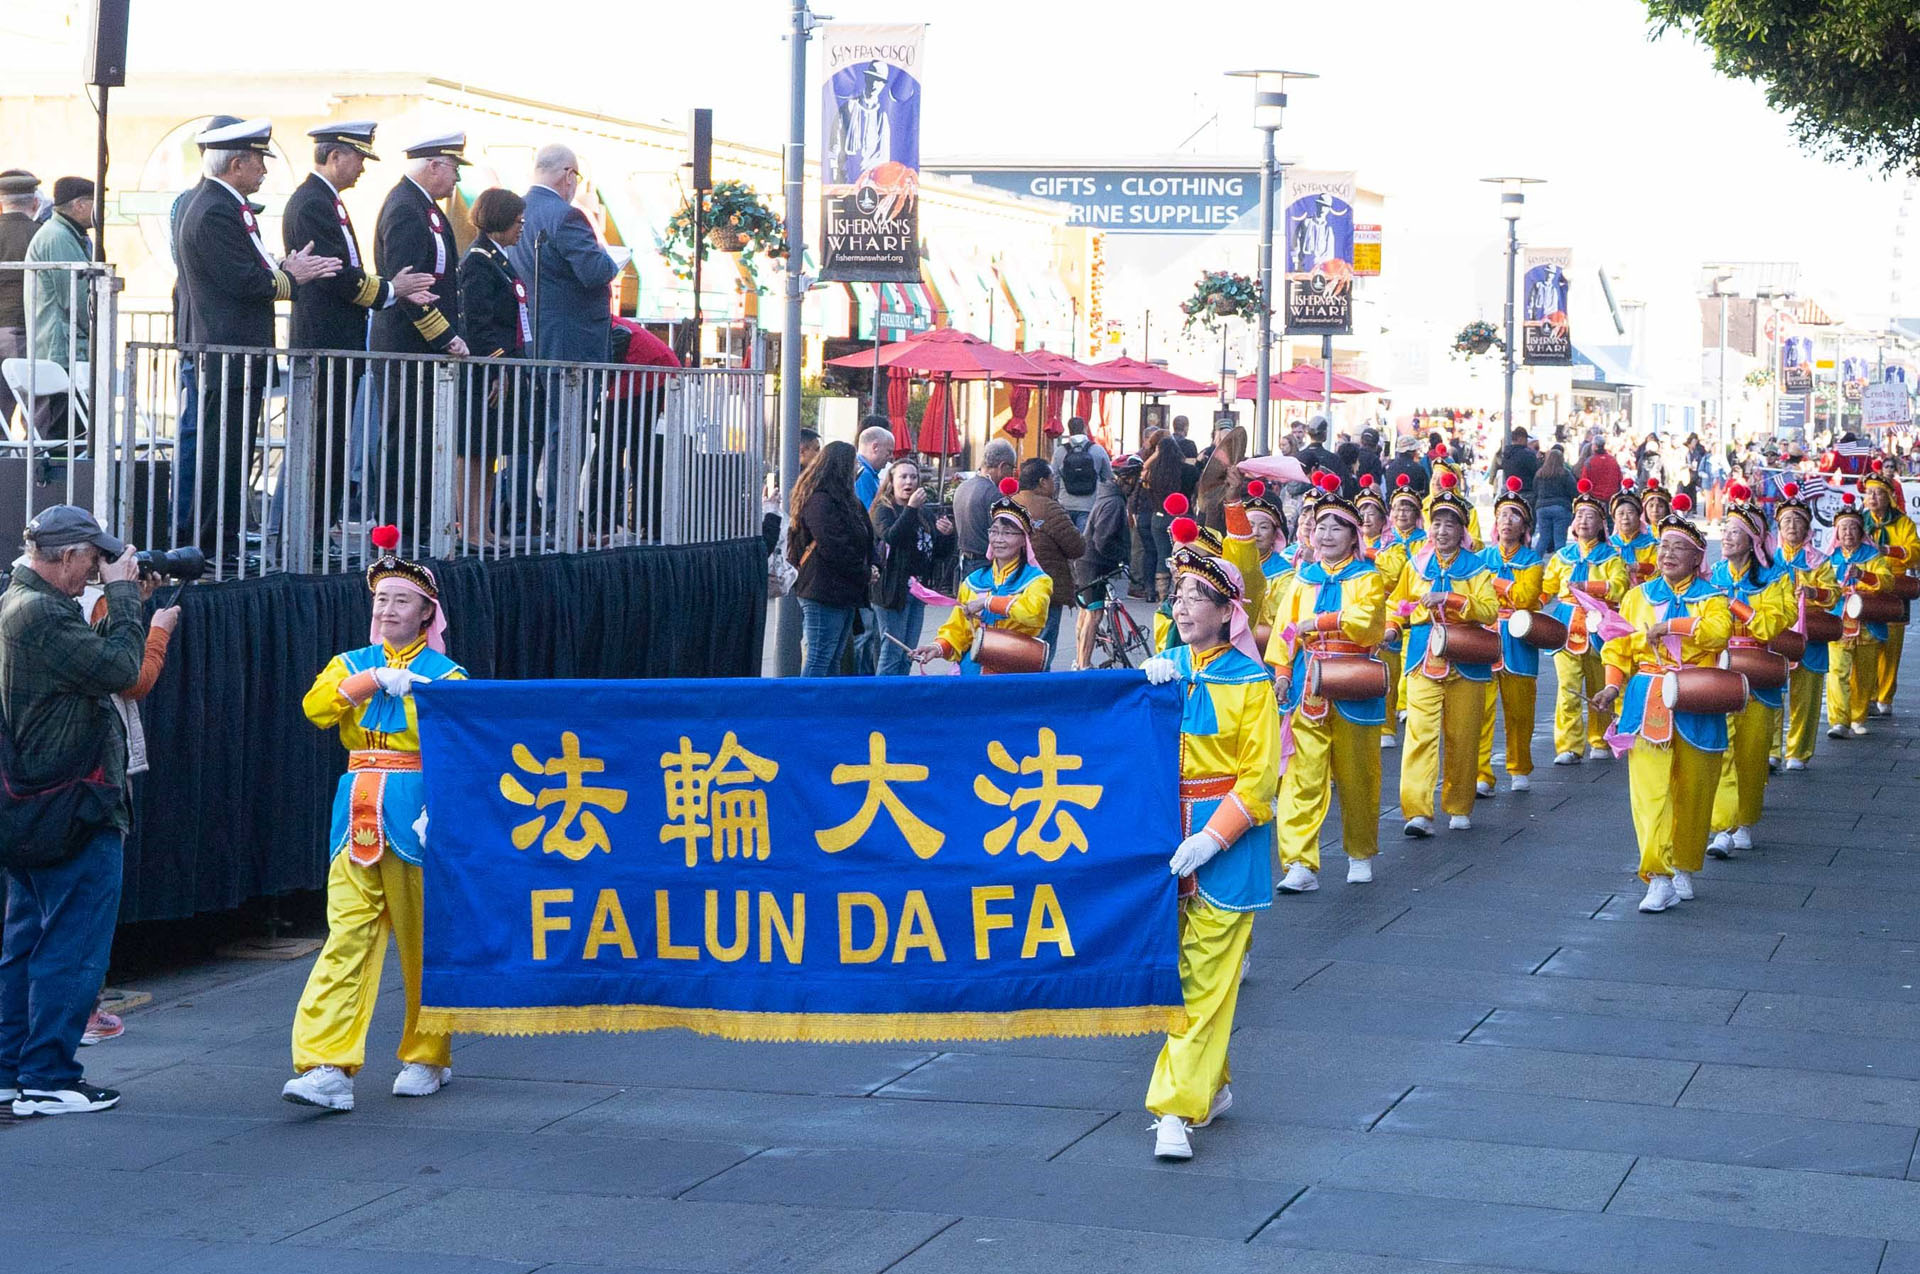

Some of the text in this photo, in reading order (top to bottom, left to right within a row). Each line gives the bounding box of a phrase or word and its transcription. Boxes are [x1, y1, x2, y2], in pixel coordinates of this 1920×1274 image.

[831, 45, 915, 67] SAN FRANCISCO
[1031, 178, 1243, 196] GIFTS CLOTHING
[827, 199, 911, 235] FISHERMAN'S
[1069, 205, 1239, 224] RINE SUPPLIES
[827, 236, 912, 251] WHARF
[835, 254, 904, 263] fishermanswharf.org
[1290, 306, 1348, 316] WHARF
[500, 727, 1103, 867] 法輪大法
[531, 884, 1075, 964] FALUN DA FA
